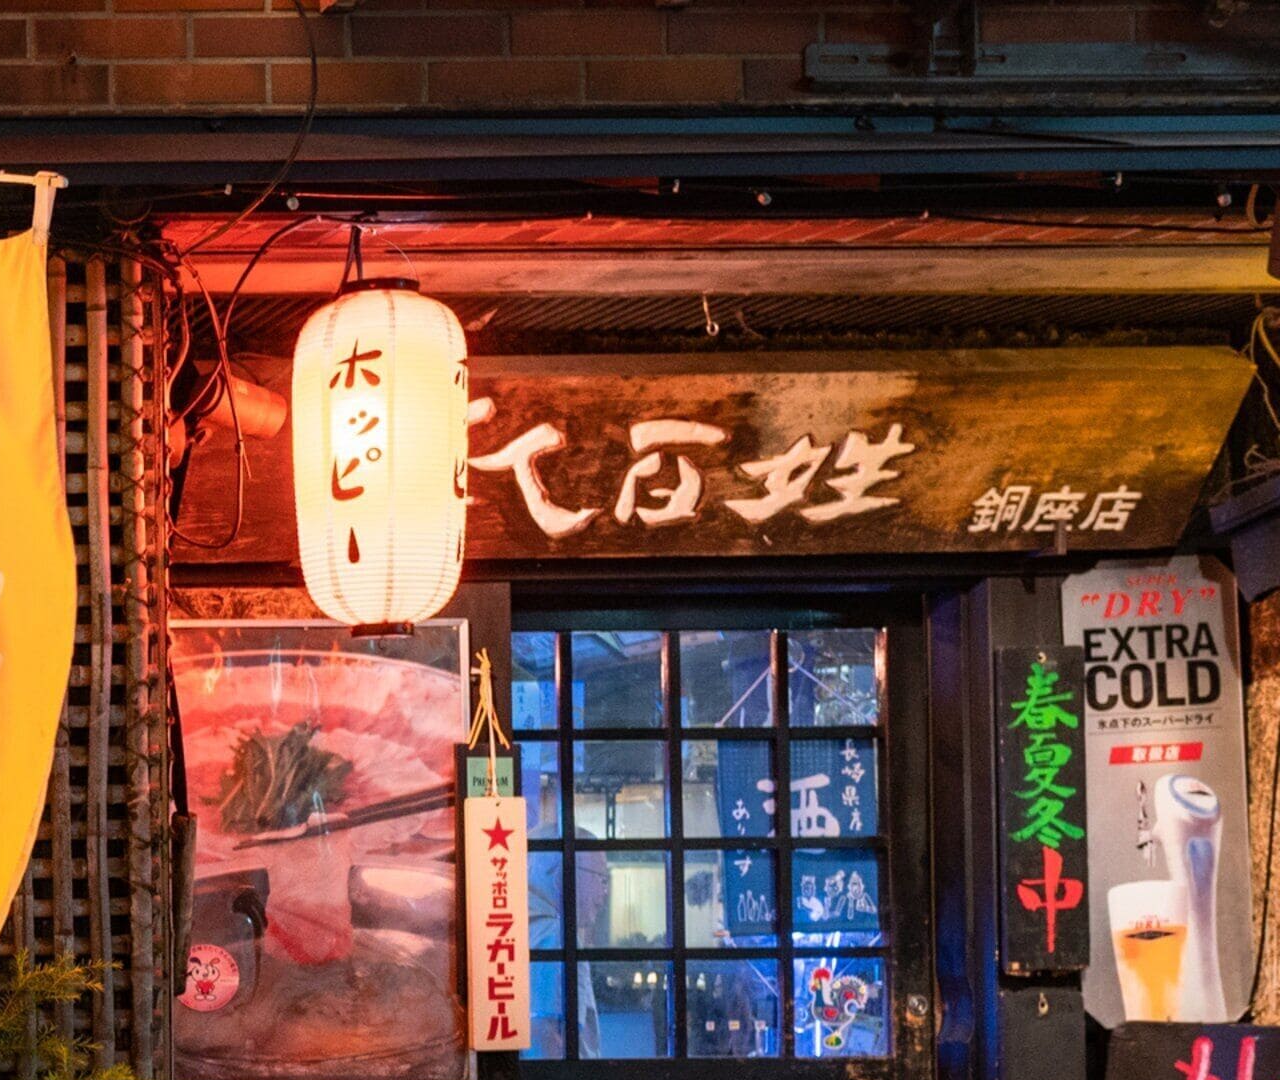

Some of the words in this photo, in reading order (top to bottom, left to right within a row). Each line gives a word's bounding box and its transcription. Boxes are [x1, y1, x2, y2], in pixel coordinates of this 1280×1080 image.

[329, 338, 383, 564] ホッピー
[968, 484, 1142, 532] 銅座店
[1083, 622, 1219, 663] EXTRA
[1086, 660, 1221, 711] COLD
[1098, 713, 1214, 729] 氷点下のスーパードライ
[1007, 662, 1085, 953] 春夏冬中
